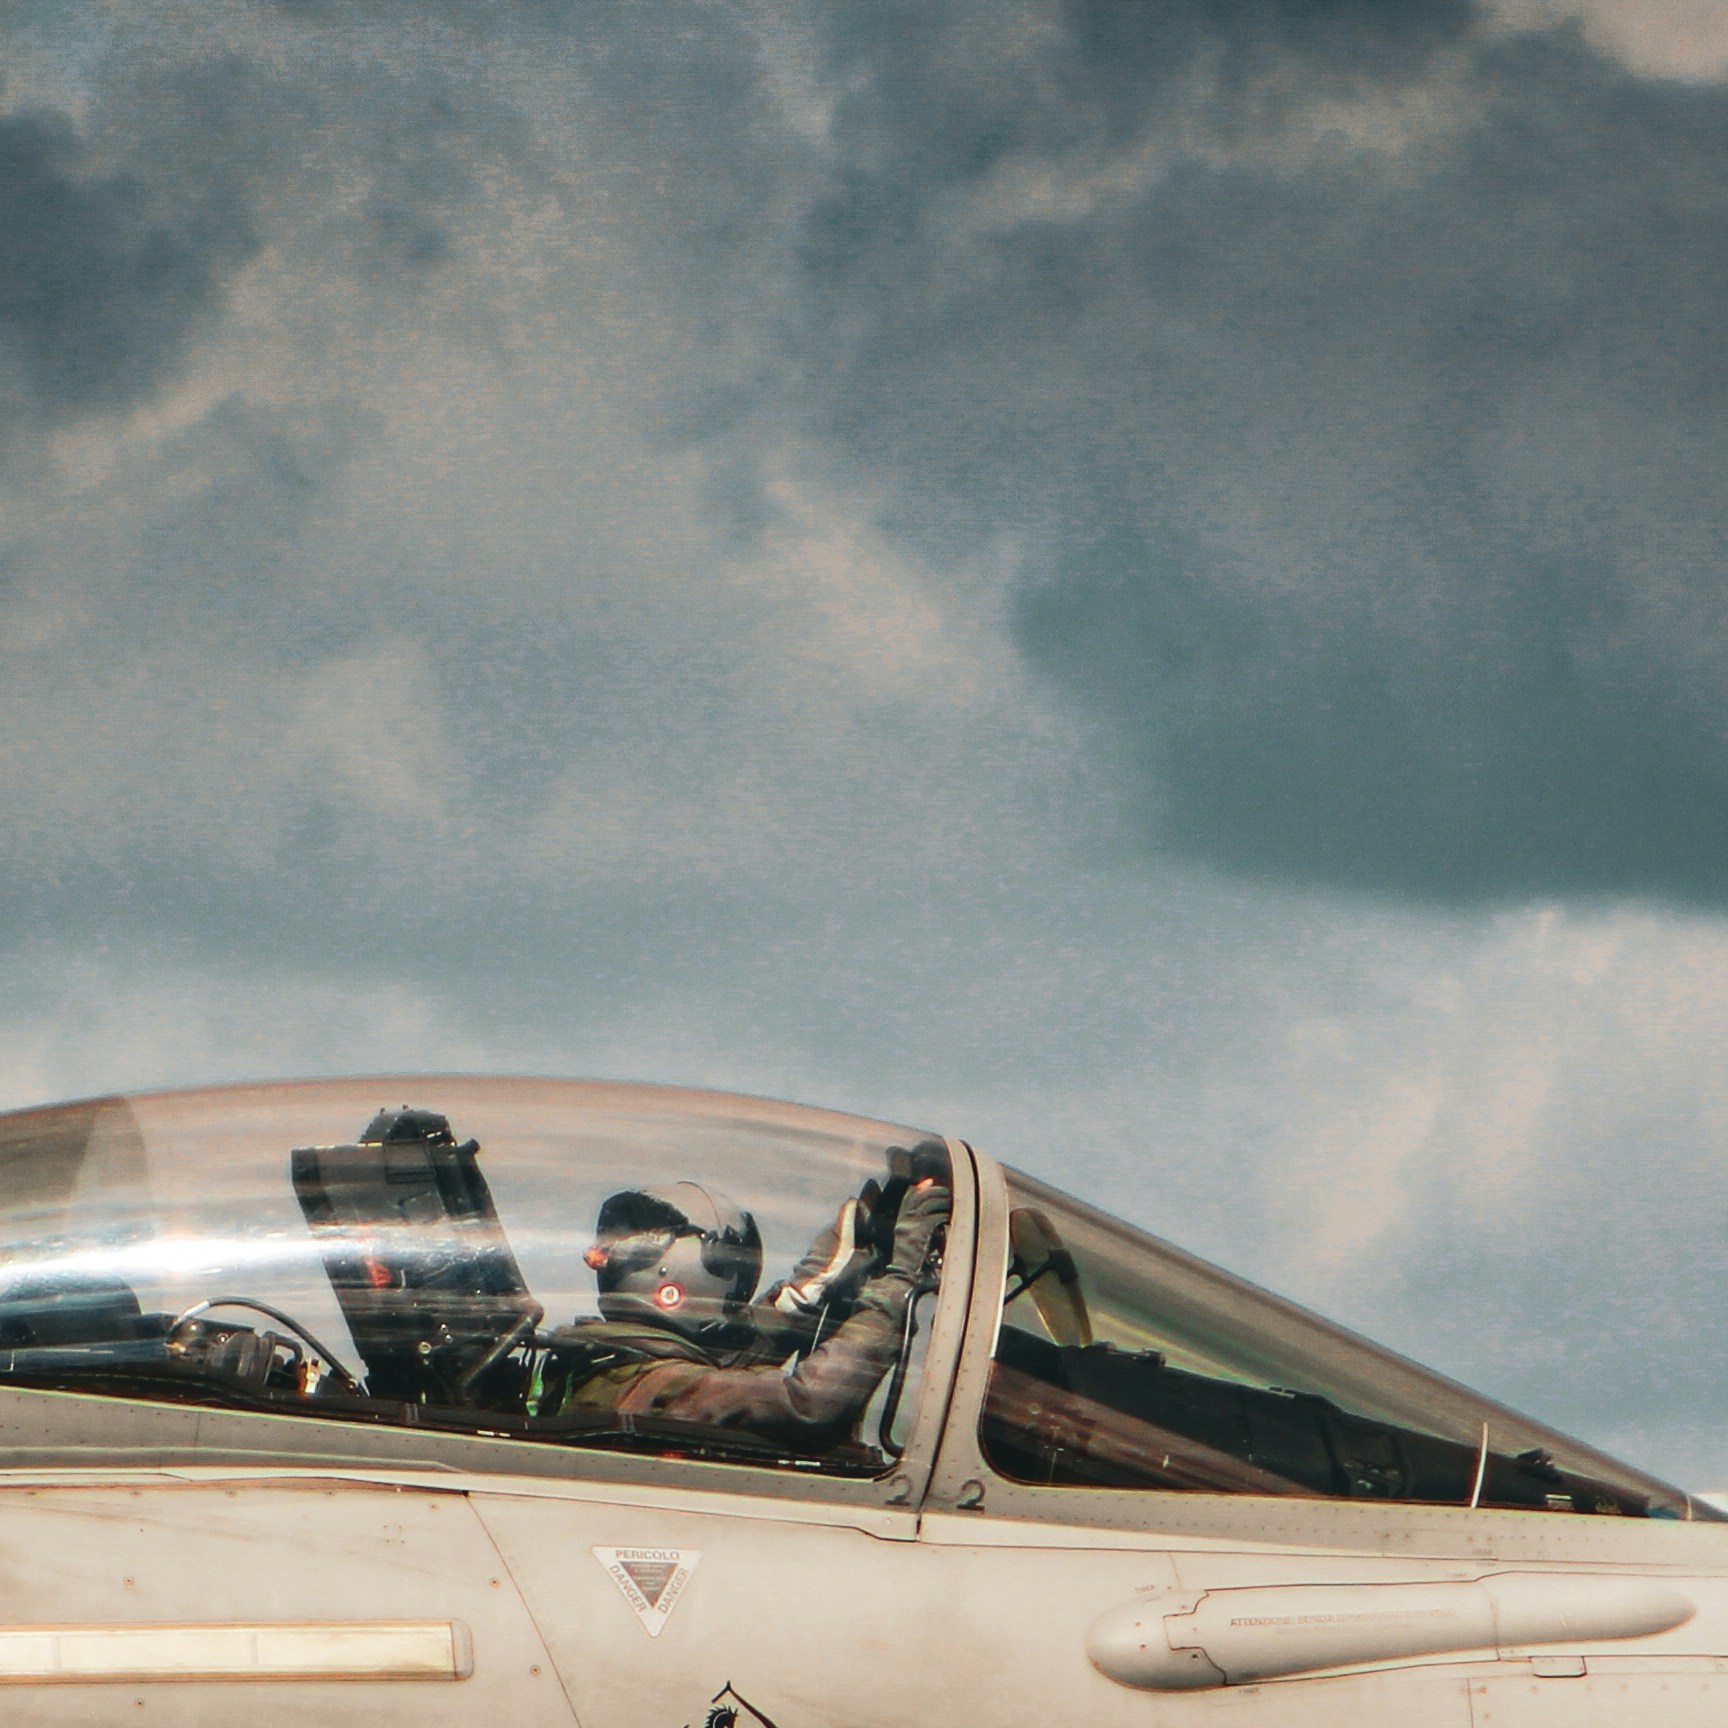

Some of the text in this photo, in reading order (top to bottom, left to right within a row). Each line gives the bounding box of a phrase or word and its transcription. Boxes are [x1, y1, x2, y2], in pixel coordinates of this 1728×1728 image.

[615, 1549, 680, 1560] PERICOLO
[609, 1564, 647, 1612] DANGER
[658, 1567, 689, 1614] DANGER
